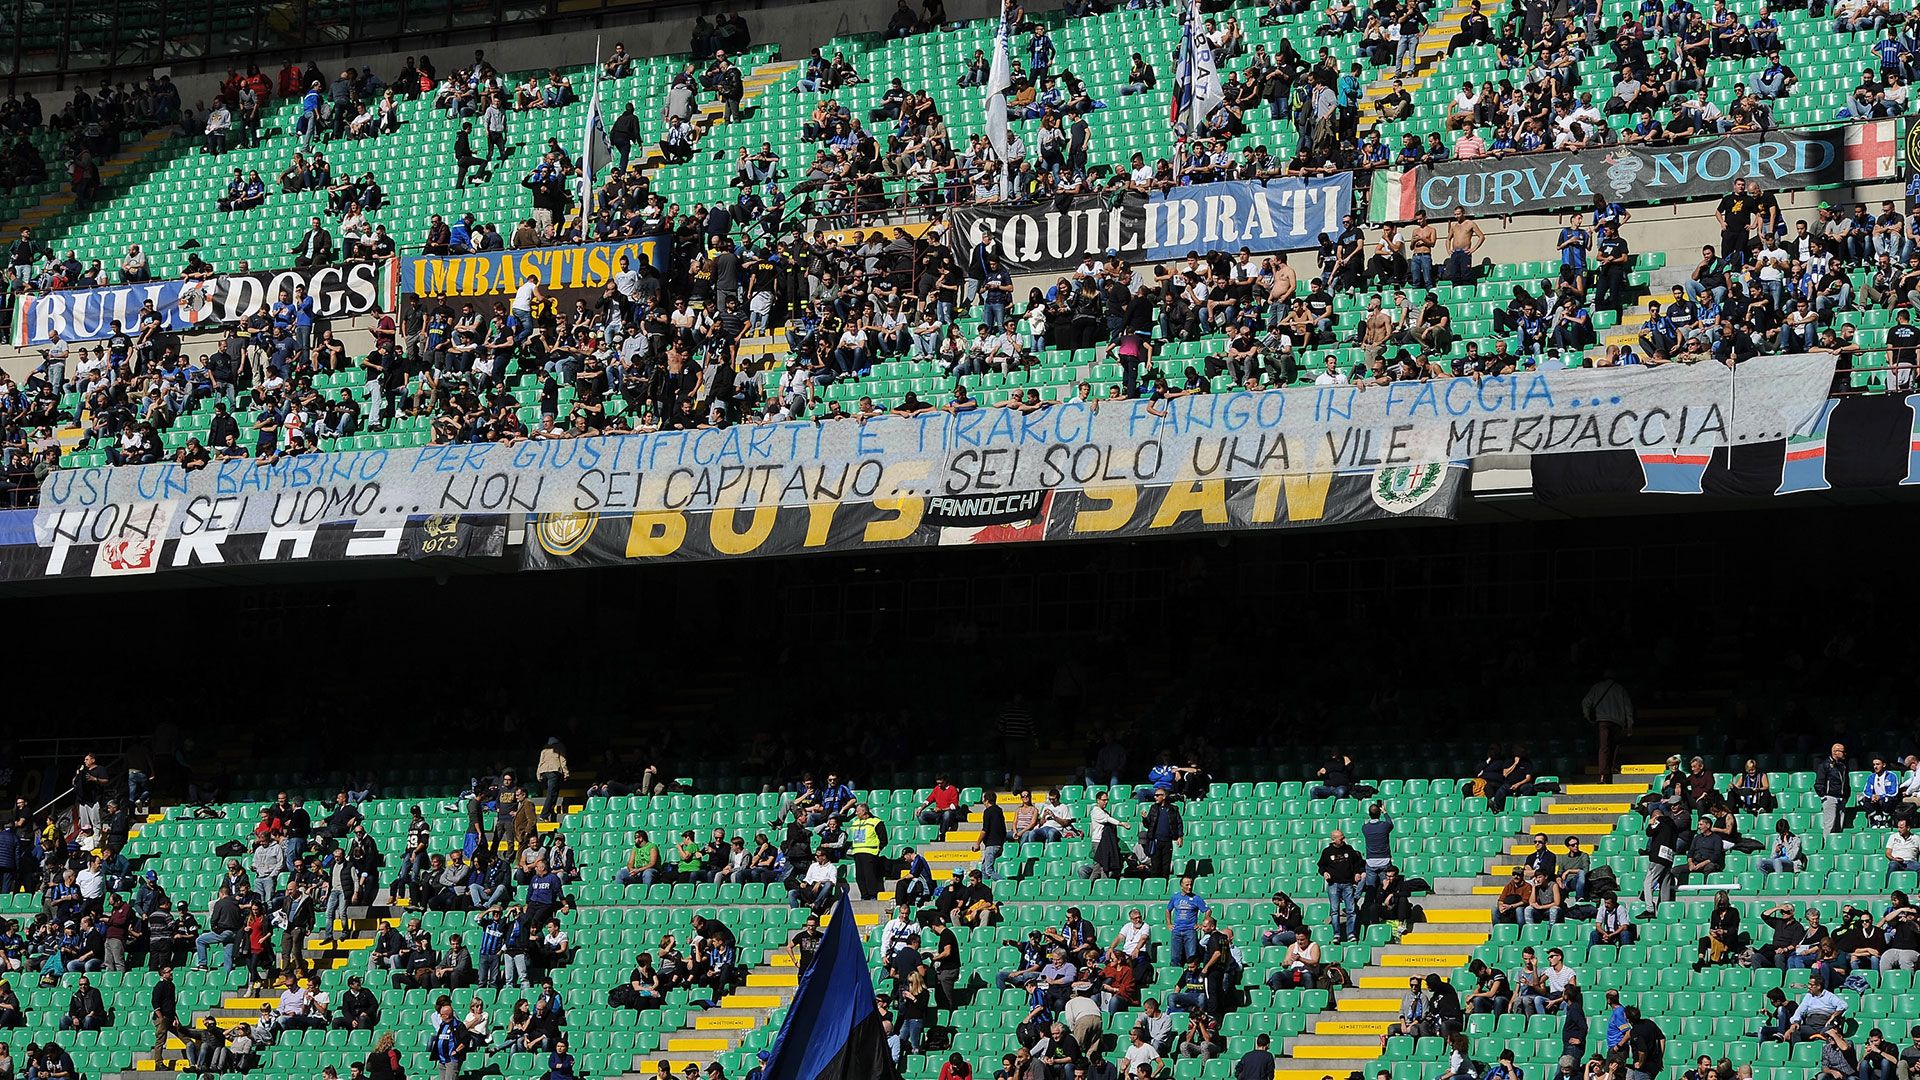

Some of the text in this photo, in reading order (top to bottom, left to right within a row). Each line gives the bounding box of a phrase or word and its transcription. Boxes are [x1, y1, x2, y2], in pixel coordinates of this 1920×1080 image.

[1421, 139, 1837, 211] CURVA NORD
[969, 185, 1343, 263] SQUILIBRATI
[51, 468, 110, 506] USI
[137, 461, 189, 500] UN
[216, 449, 389, 494] BAMBINO
[411, 440, 494, 472] PER
[512, 424, 824, 472] GIUSTIFICARTI
[857, 416, 887, 456] E
[914, 402, 1097, 452] TIRARCI
[1129, 388, 1286, 436] FANGO
[1315, 387, 1354, 422] IN
[52, 499, 158, 543] NON
[180, 496, 248, 536] SEI
[440, 473, 544, 512] NON
[575, 469, 642, 510] SEI
[946, 450, 1018, 493] SEI
[1042, 440, 1162, 486] SOLO
[1193, 434, 1290, 476] UNA
[1326, 424, 1414, 466] VILE
[626, 446, 1333, 558] BOYS SAN
[927, 491, 1040, 517] PANNOCCHI
[421, 536, 458, 553] 1975
